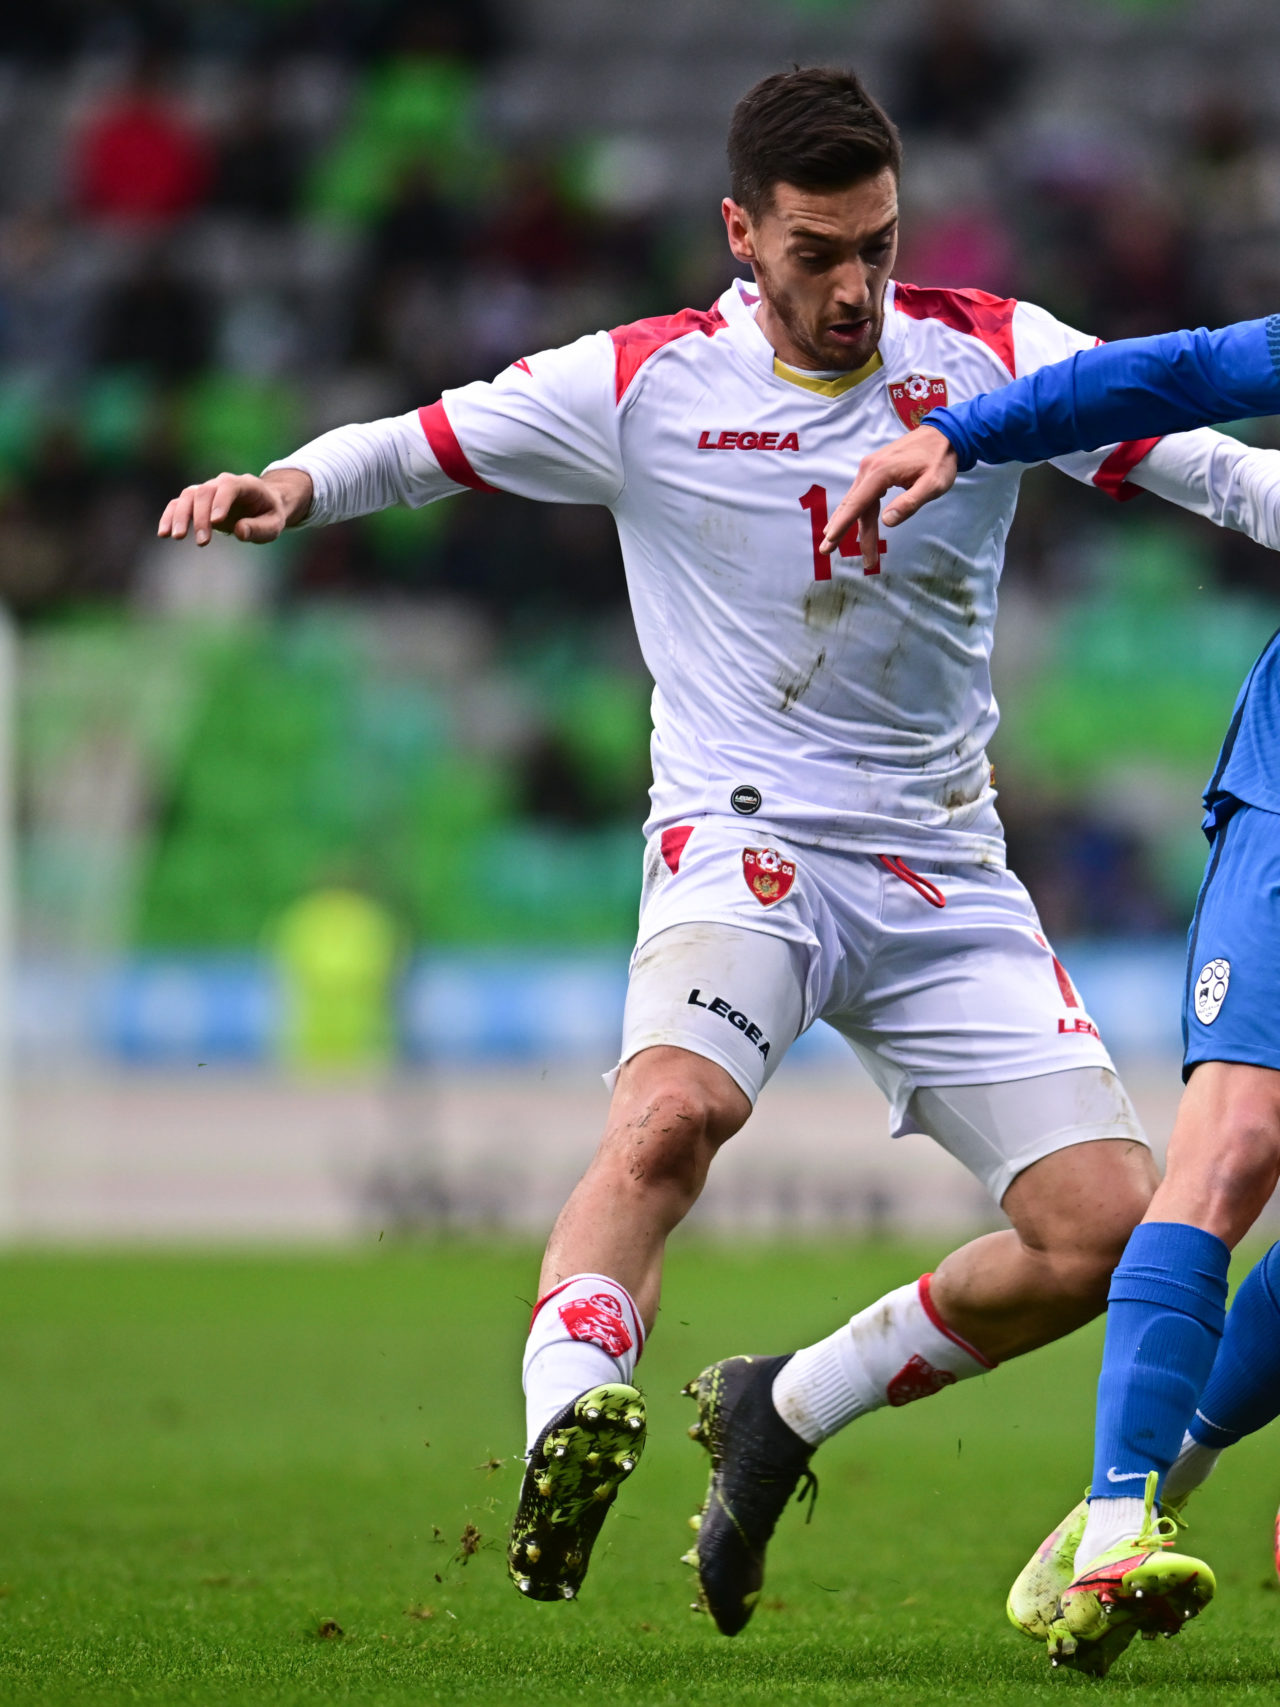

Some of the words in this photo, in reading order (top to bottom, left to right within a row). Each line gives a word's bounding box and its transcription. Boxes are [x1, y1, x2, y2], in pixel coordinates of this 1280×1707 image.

[893, 389, 904, 399] FS
[932, 384, 945, 394] CG
[697, 430, 800, 452] LEGEA
[687, 988, 771, 1062] LEGEA
